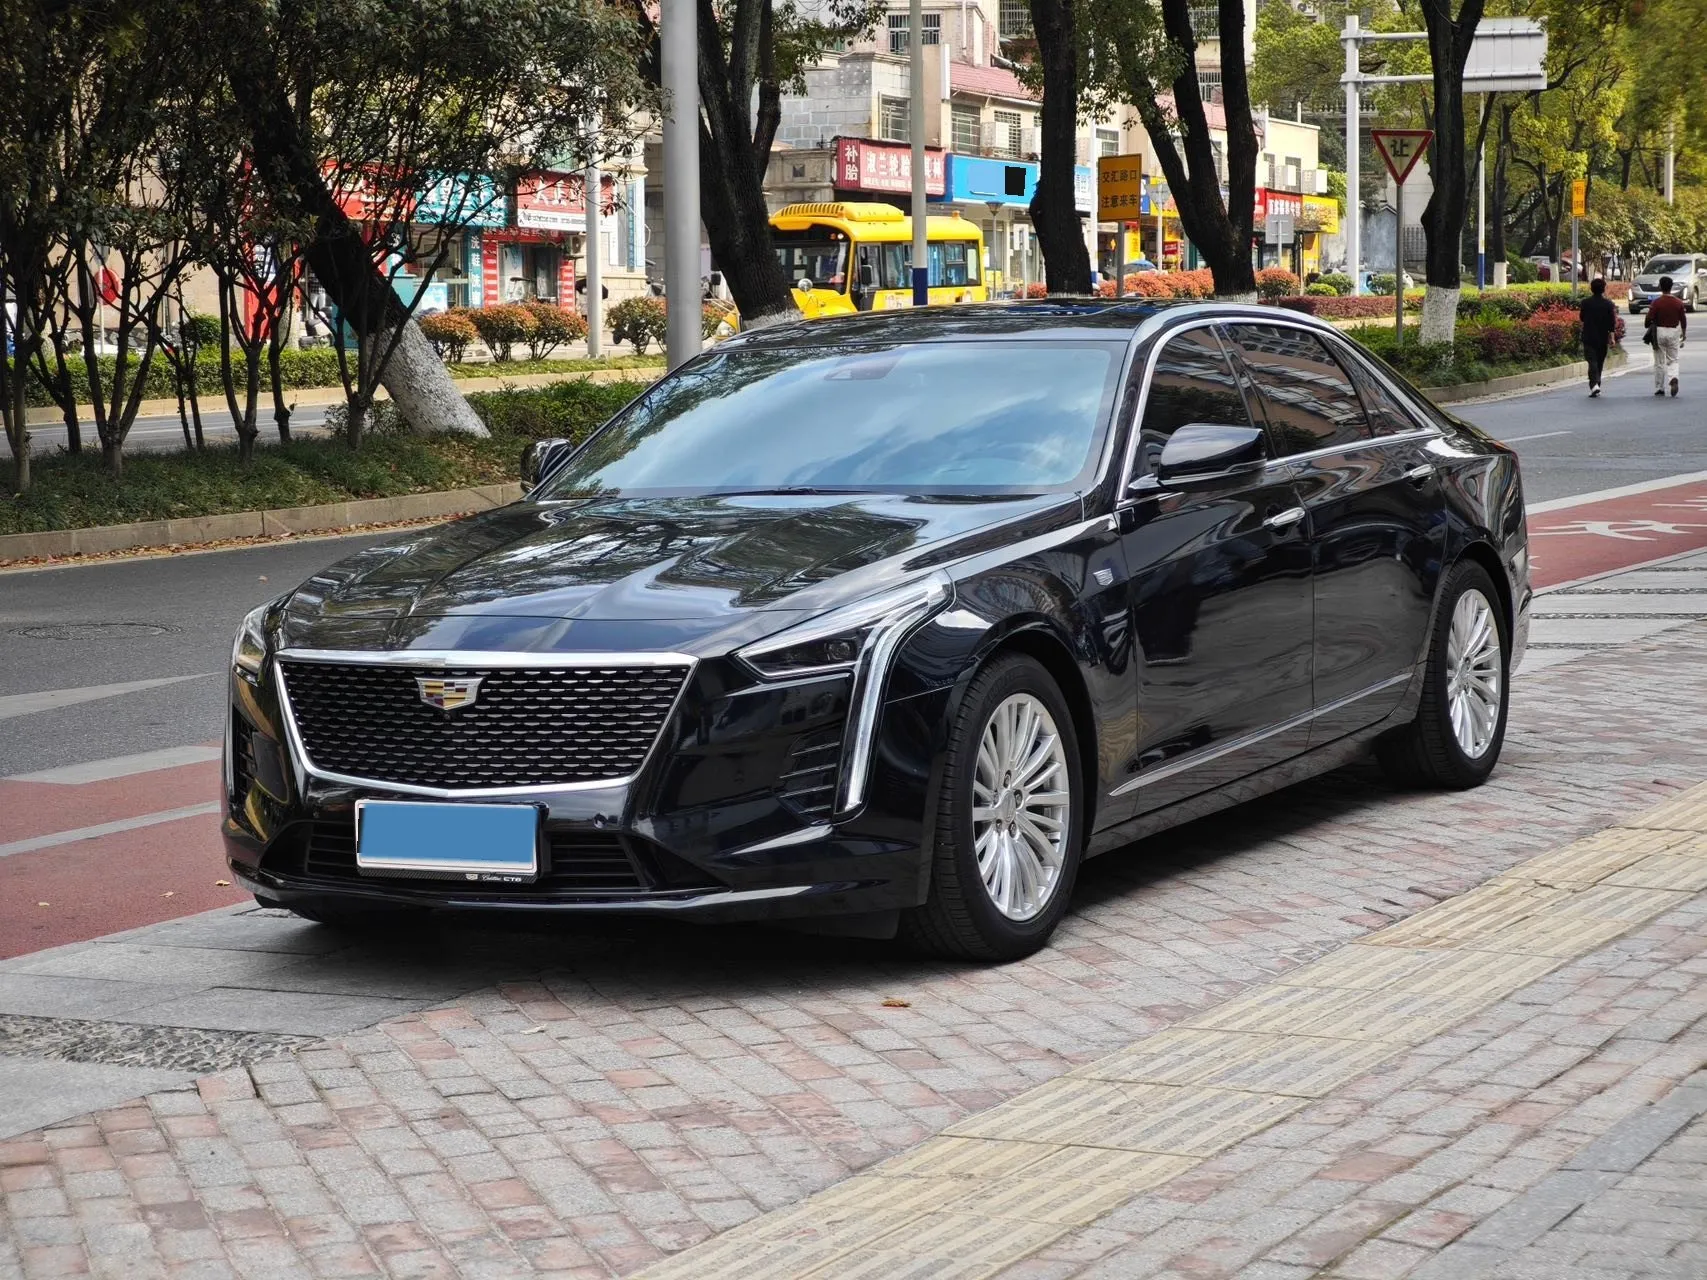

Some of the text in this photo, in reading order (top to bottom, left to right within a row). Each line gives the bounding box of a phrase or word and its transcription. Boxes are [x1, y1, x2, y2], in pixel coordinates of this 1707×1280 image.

[1390, 139, 1409, 157] 让
[845, 145, 858, 181] 补胎
[1102, 169, 1137, 183] 交汇路口
[1101, 193, 1138, 208] 注意来车
